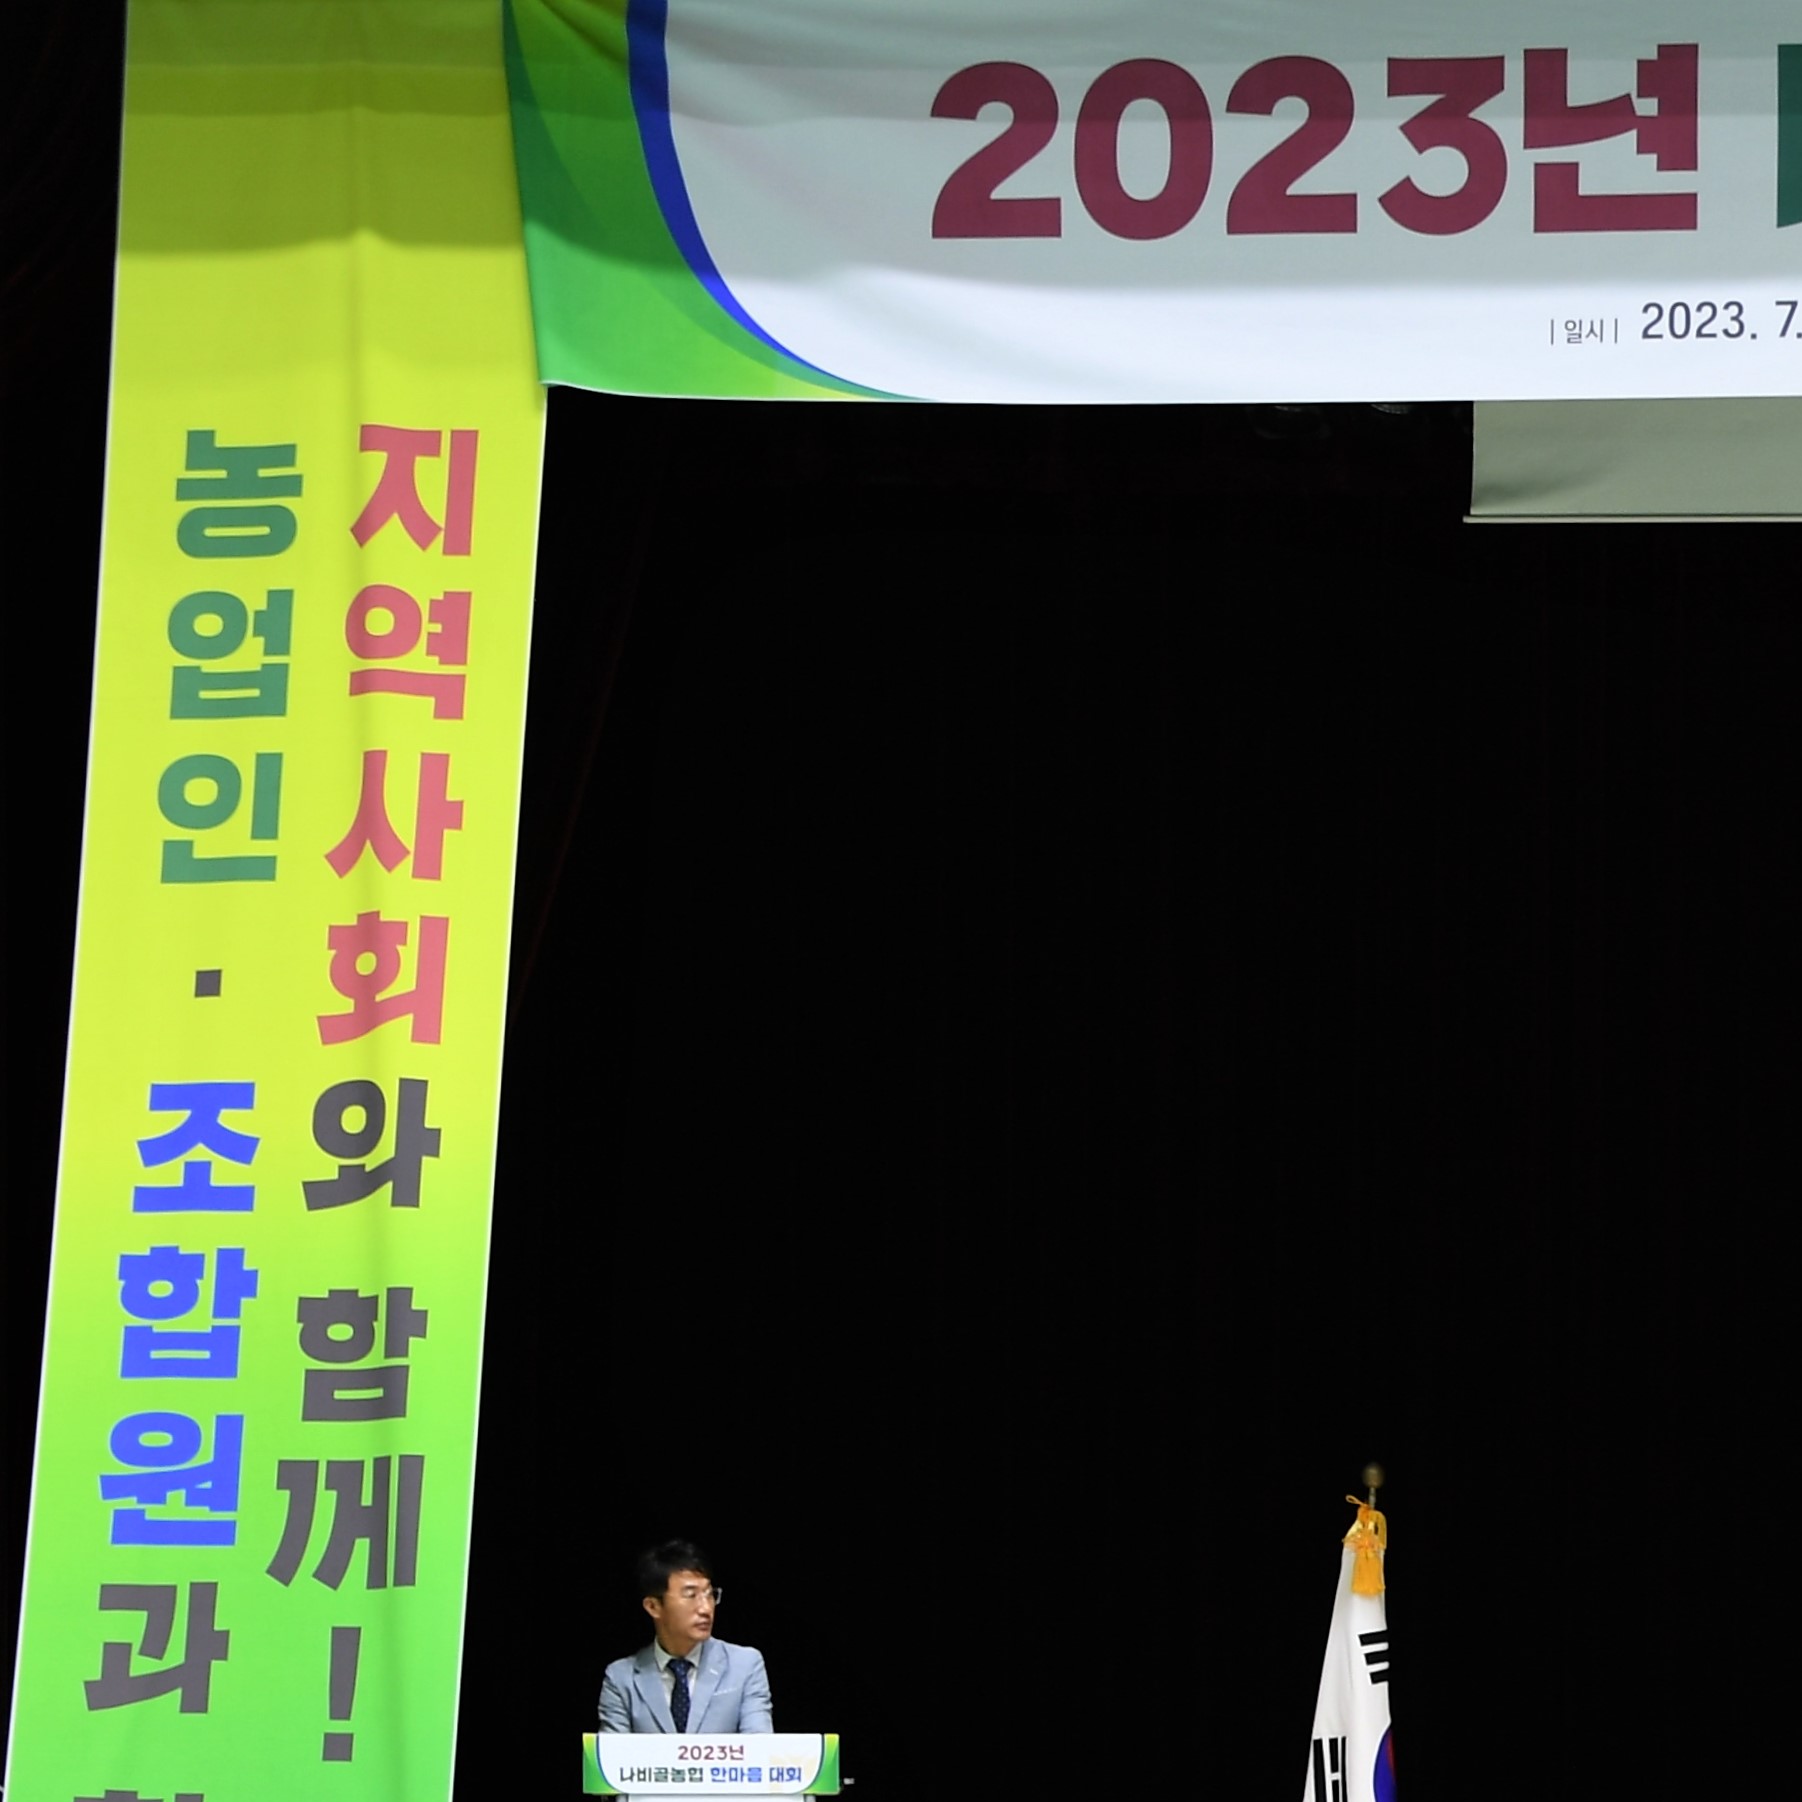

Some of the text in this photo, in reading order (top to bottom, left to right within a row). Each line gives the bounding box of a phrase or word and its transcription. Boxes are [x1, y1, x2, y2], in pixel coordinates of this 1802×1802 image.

[929, 42, 1699, 240] 2023년
[1641, 301, 1757, 340] 2023.
[265, 424, 479, 1763] 지역사회와 함께!
[677, 1744, 745, 1761] 2023년
[768, 1766, 803, 1783] 대회
